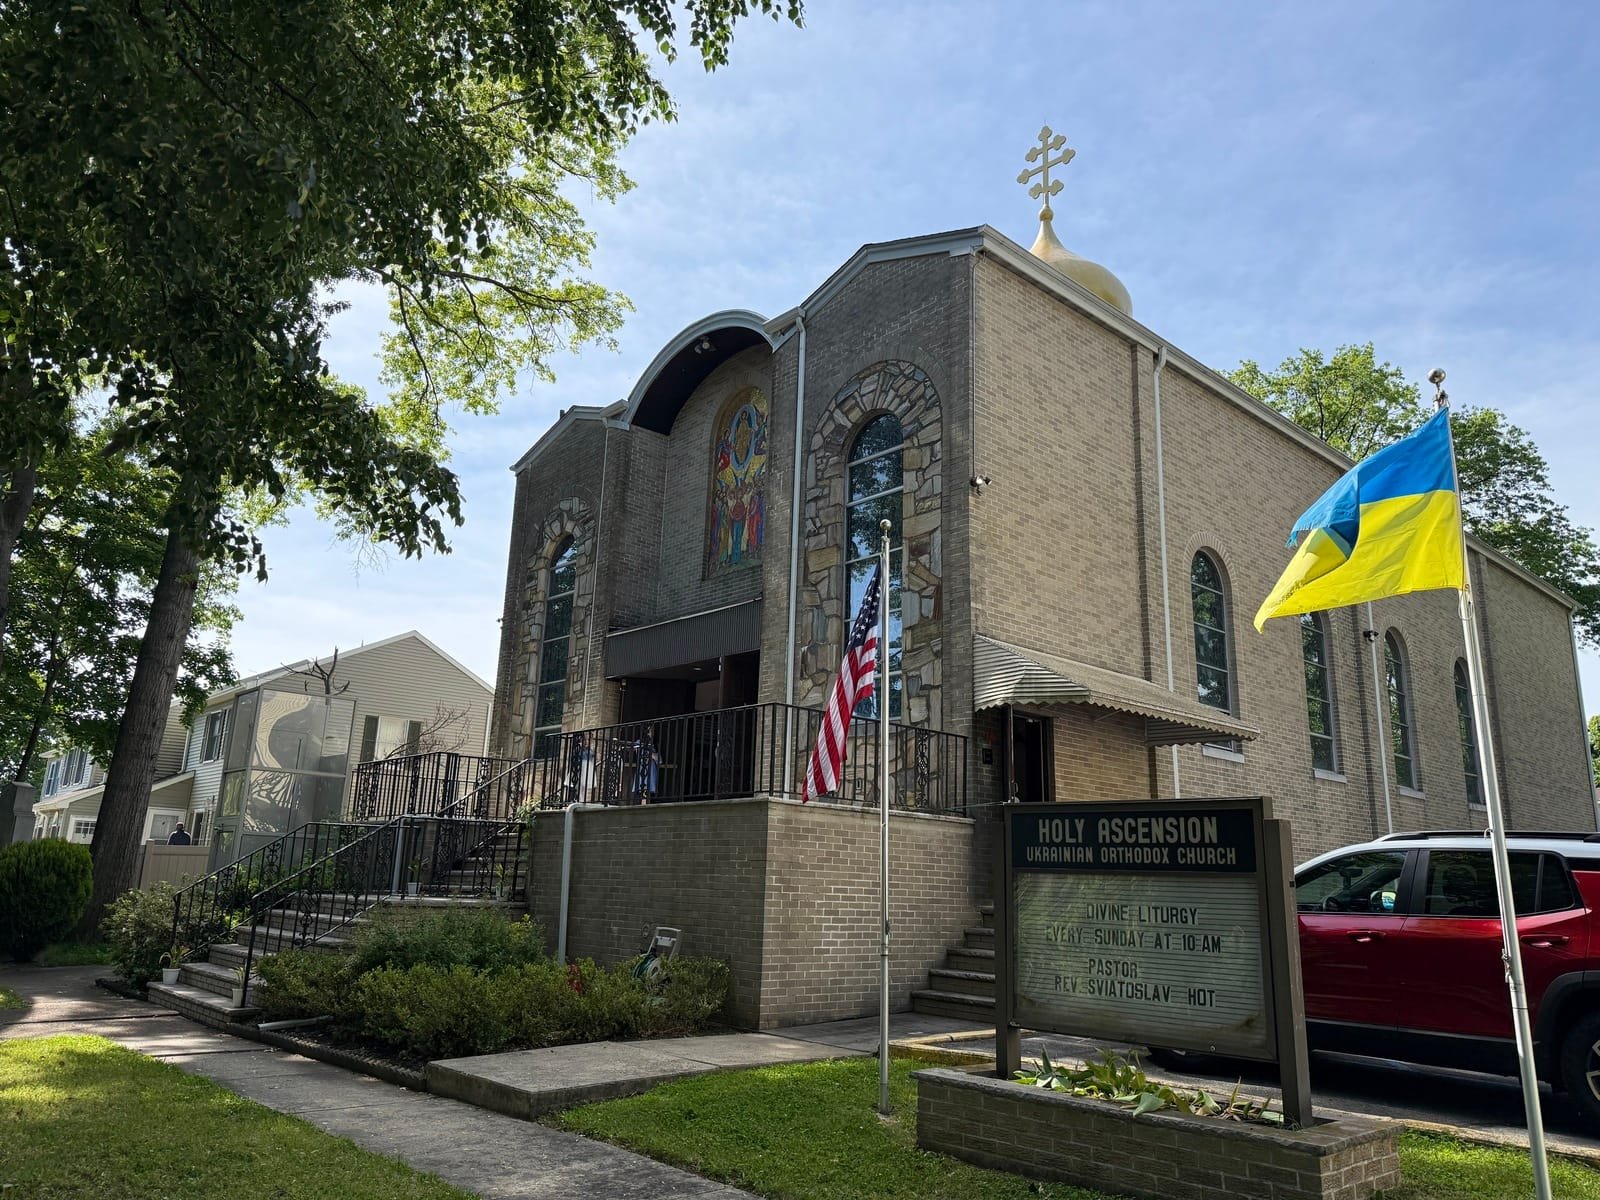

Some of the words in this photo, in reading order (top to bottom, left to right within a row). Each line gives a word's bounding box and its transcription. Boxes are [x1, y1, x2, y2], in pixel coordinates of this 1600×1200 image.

[1038, 818, 1085, 844] HOLY
[1098, 816, 1218, 844] ASCENSION
[1026, 847, 1094, 863] UKRAINIAN
[1101, 847, 1170, 864] ORTHODOX
[1177, 847, 1237, 865] CHURCH
[1086, 903, 1129, 921] DIVINE
[1138, 906, 1198, 925] LITURGY
[1046, 926, 1083, 944] EVERY
[1094, 928, 1145, 948] SUNDAY
[1154, 932, 1172, 949] AT
[1182, 934, 1196, 951] 10
[1202, 935, 1222, 953] AM
[1088, 958, 1138, 979] PASTOR
[1088, 979, 1171, 1003] SVIATOSLAV
[1188, 987, 1216, 1007] HOT
